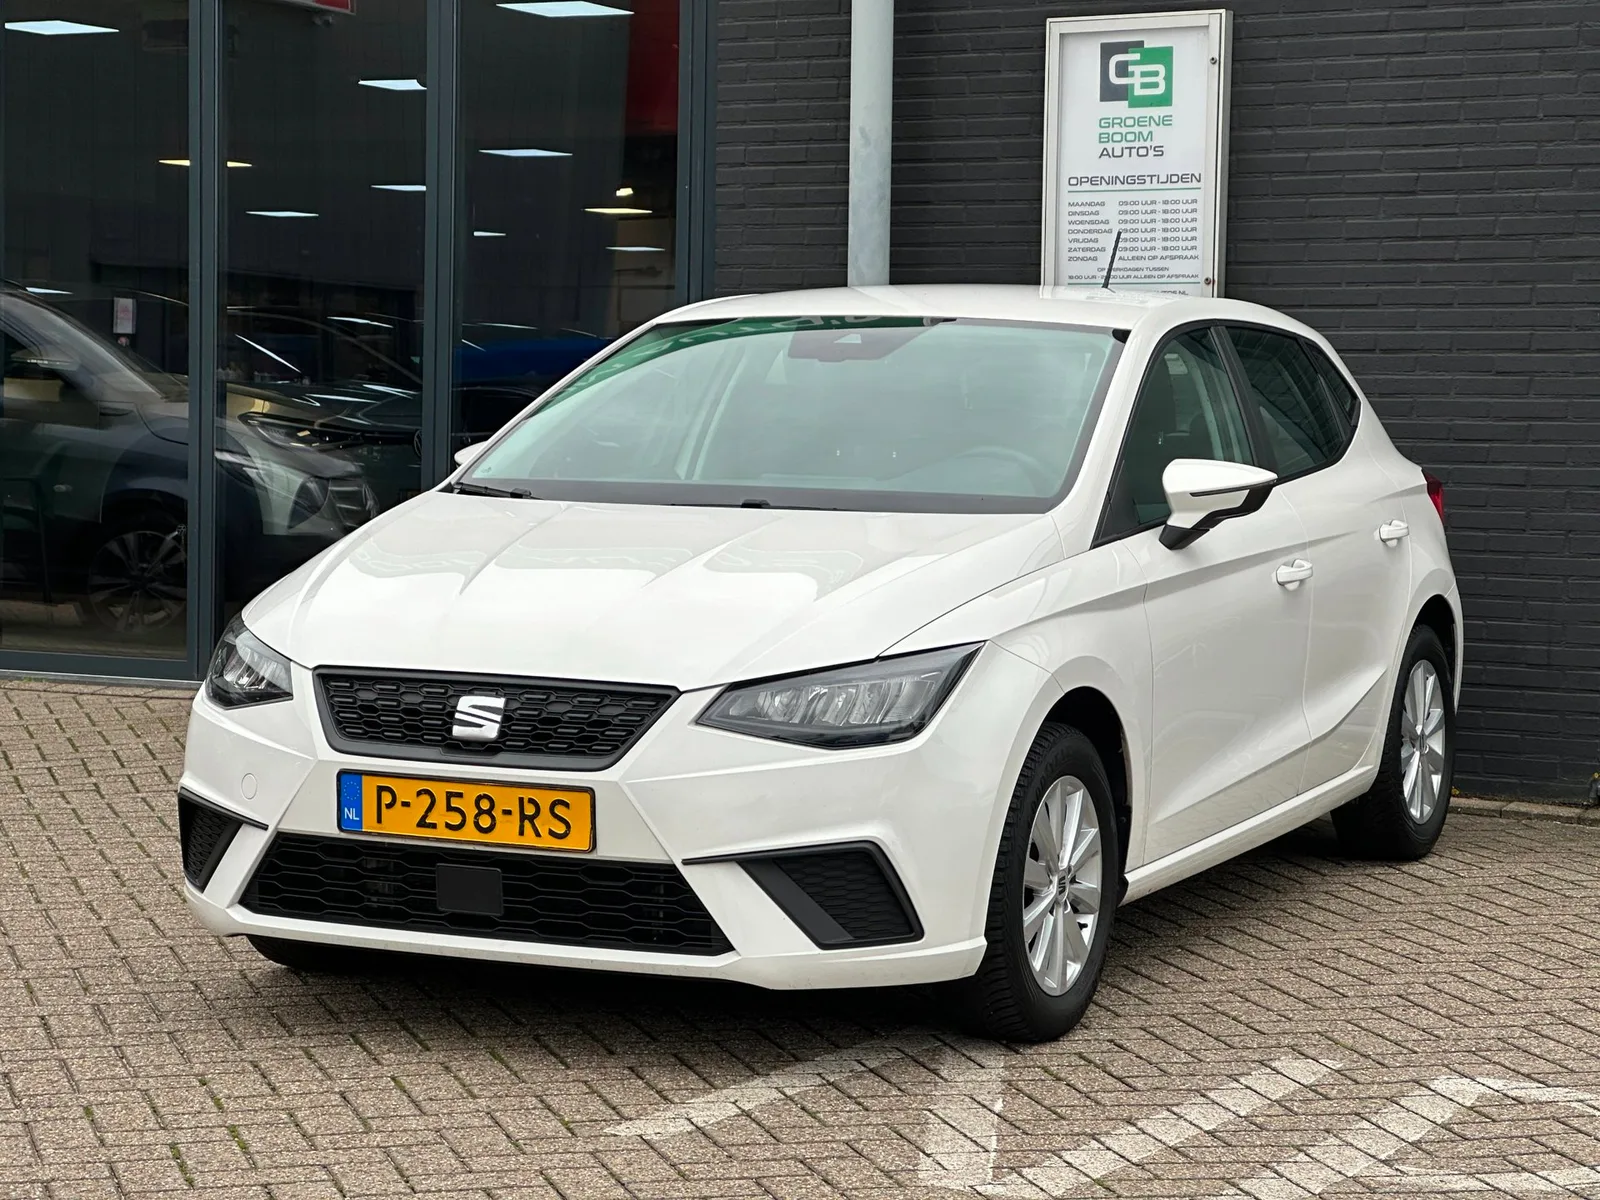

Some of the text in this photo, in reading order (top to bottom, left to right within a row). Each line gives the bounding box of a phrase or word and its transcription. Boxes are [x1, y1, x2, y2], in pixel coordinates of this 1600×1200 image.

[1099, 115, 1173, 128] GROENE
[1099, 131, 1153, 143] BOOM
[1099, 145, 1164, 158] AUTO'S
[1068, 173, 1201, 187] OPENINGSTIJDEN
[345, 808, 360, 821] NL
[376, 785, 572, 840] P-258-RS
